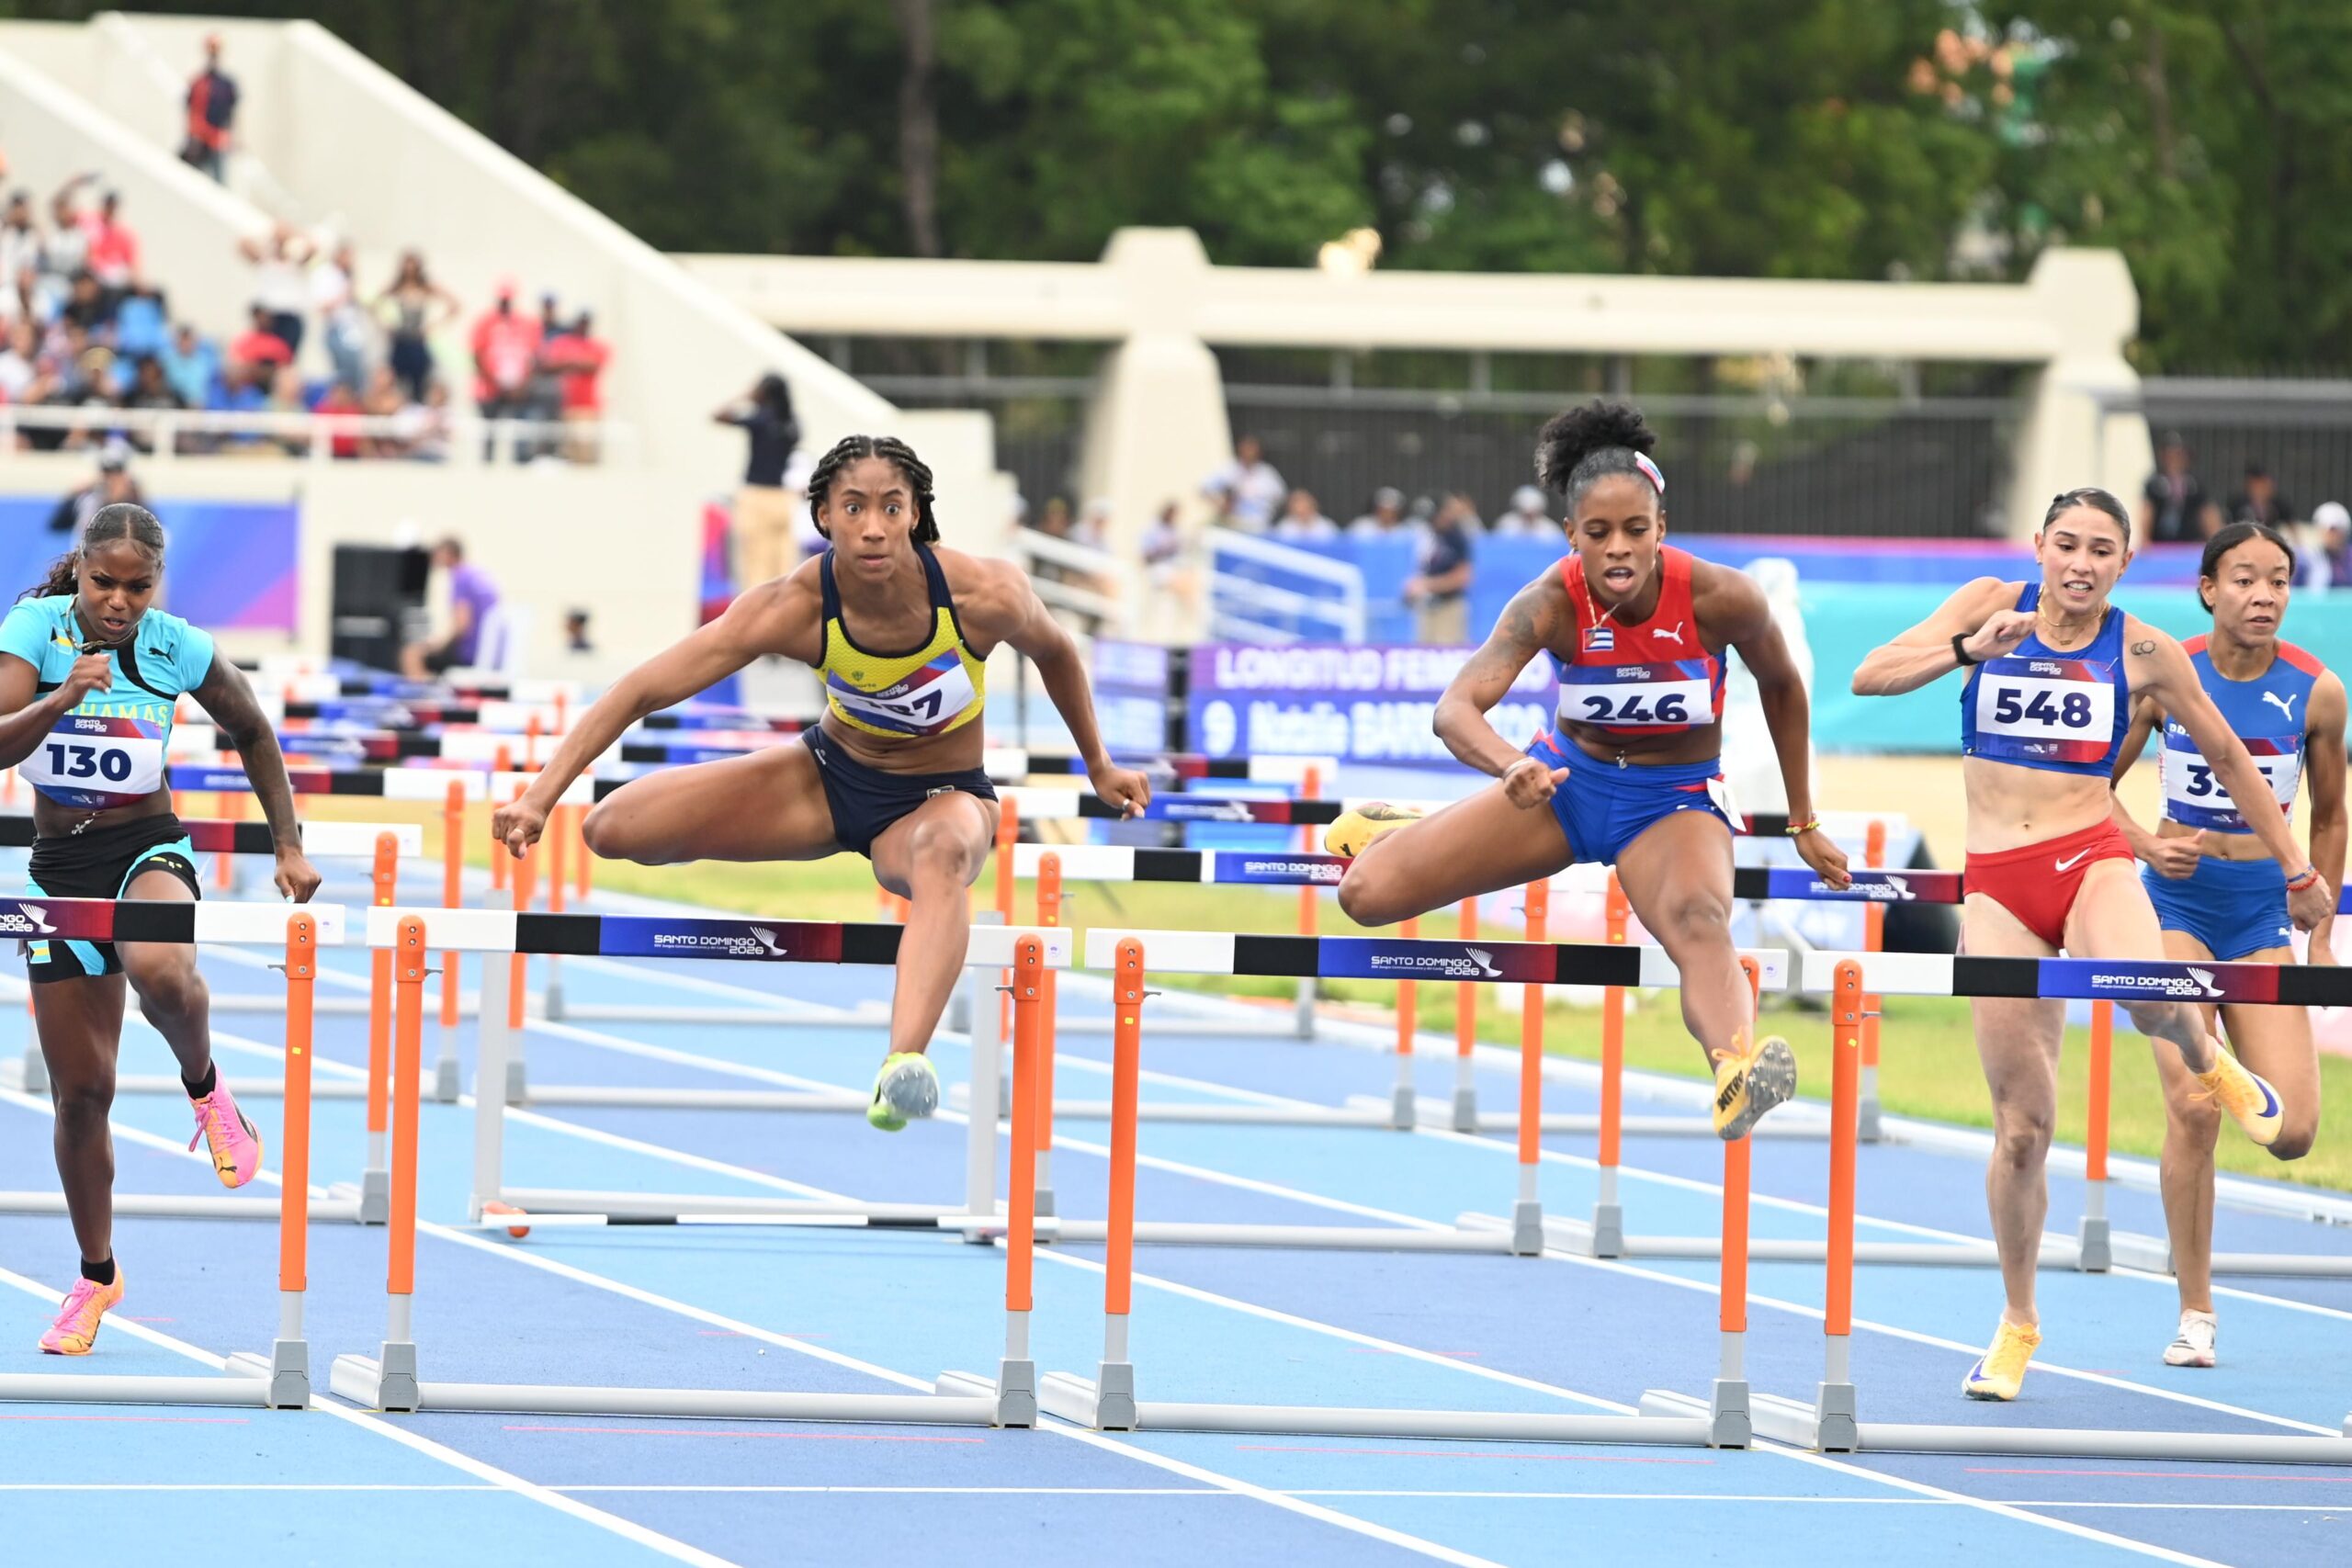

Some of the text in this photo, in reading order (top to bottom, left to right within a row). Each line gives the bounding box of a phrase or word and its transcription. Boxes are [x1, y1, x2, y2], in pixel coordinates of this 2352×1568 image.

[1582, 694, 1689, 722] 246
[1995, 688, 2092, 728] 548
[1202, 701, 1237, 758] 9
[46, 743, 132, 782] 130
[1245, 862, 1343, 873] SANTO DOMINGO
[654, 934, 756, 946] SANTO DOMINGO
[729, 945, 764, 955] 2026
[1371, 955, 1472, 967] SANTO DOMINGO
[1444, 966, 1480, 976] 2026
[2091, 975, 2194, 987] SANTO DOMINGO
[2165, 986, 2202, 996] 2026
